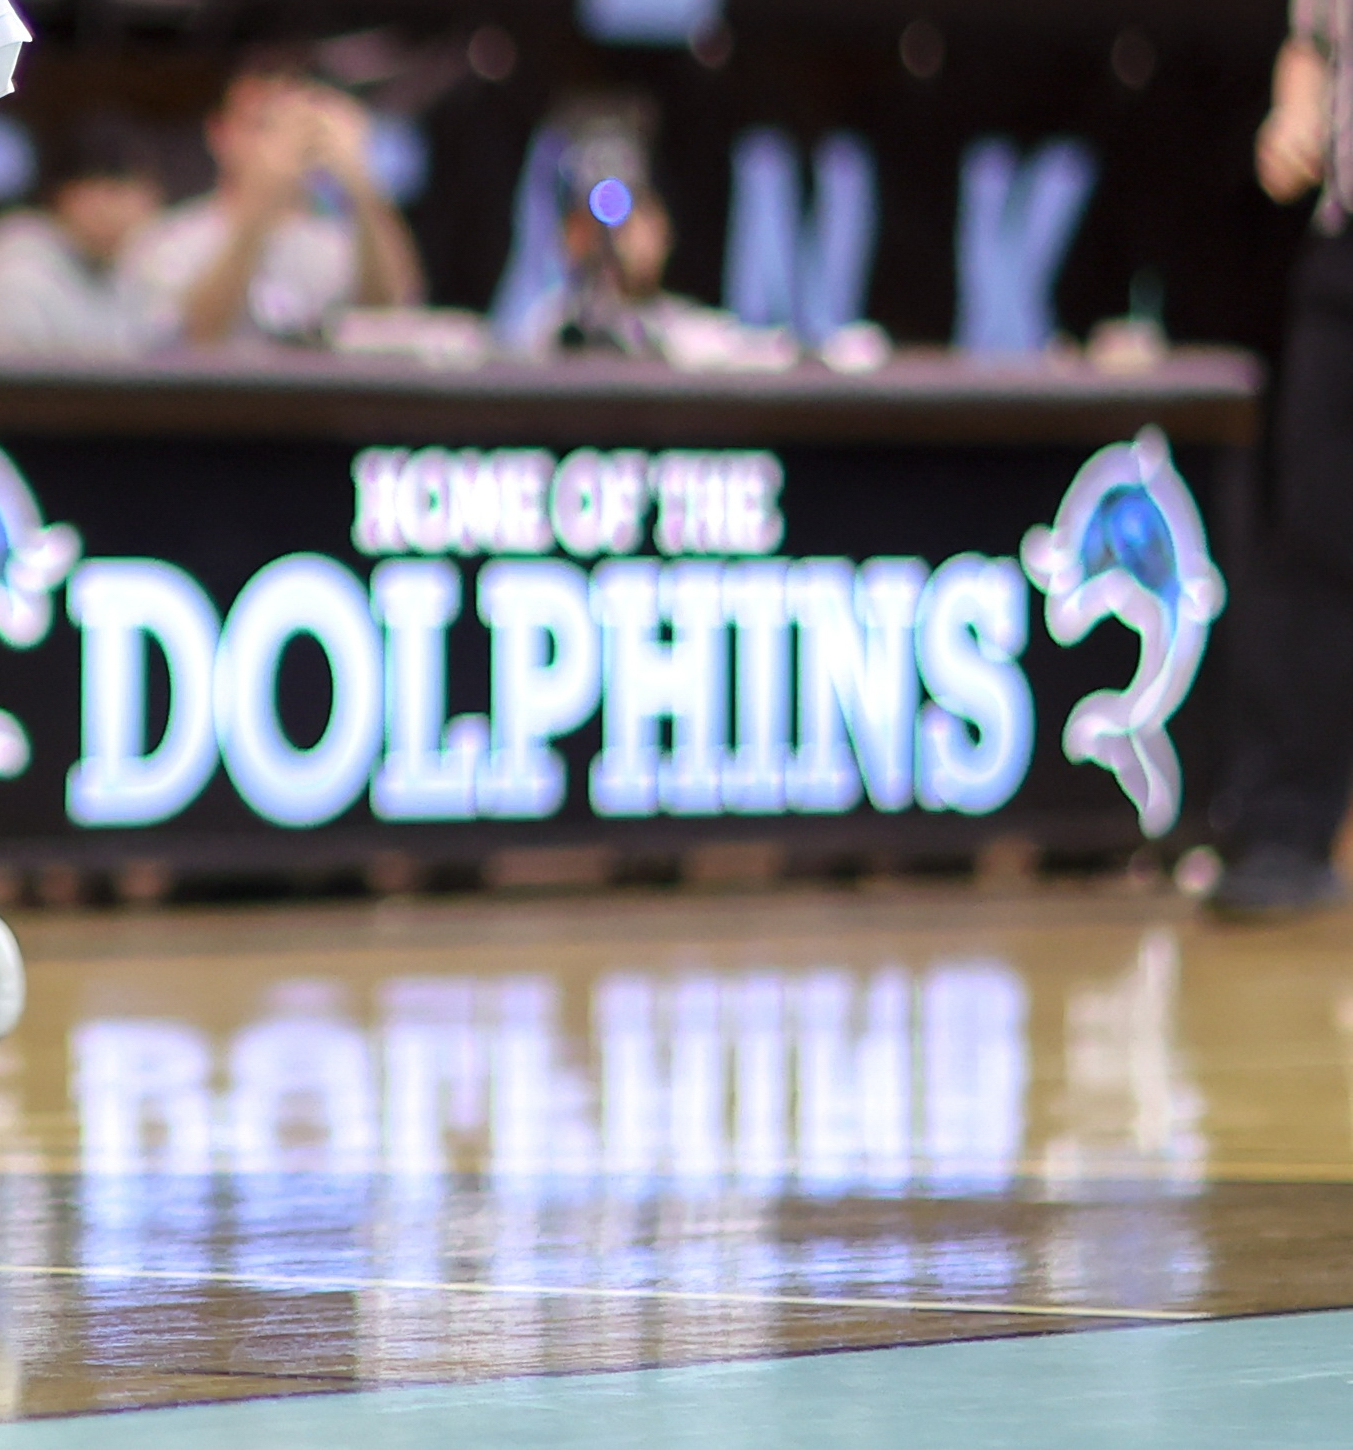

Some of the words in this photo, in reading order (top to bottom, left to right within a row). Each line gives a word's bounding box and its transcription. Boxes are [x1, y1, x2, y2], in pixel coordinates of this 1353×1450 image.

[350, 445, 555, 556] HOME
[551, 445, 649, 558] OF
[650, 448, 786, 556] THE
[62, 549, 1036, 829] DOLPHINS
